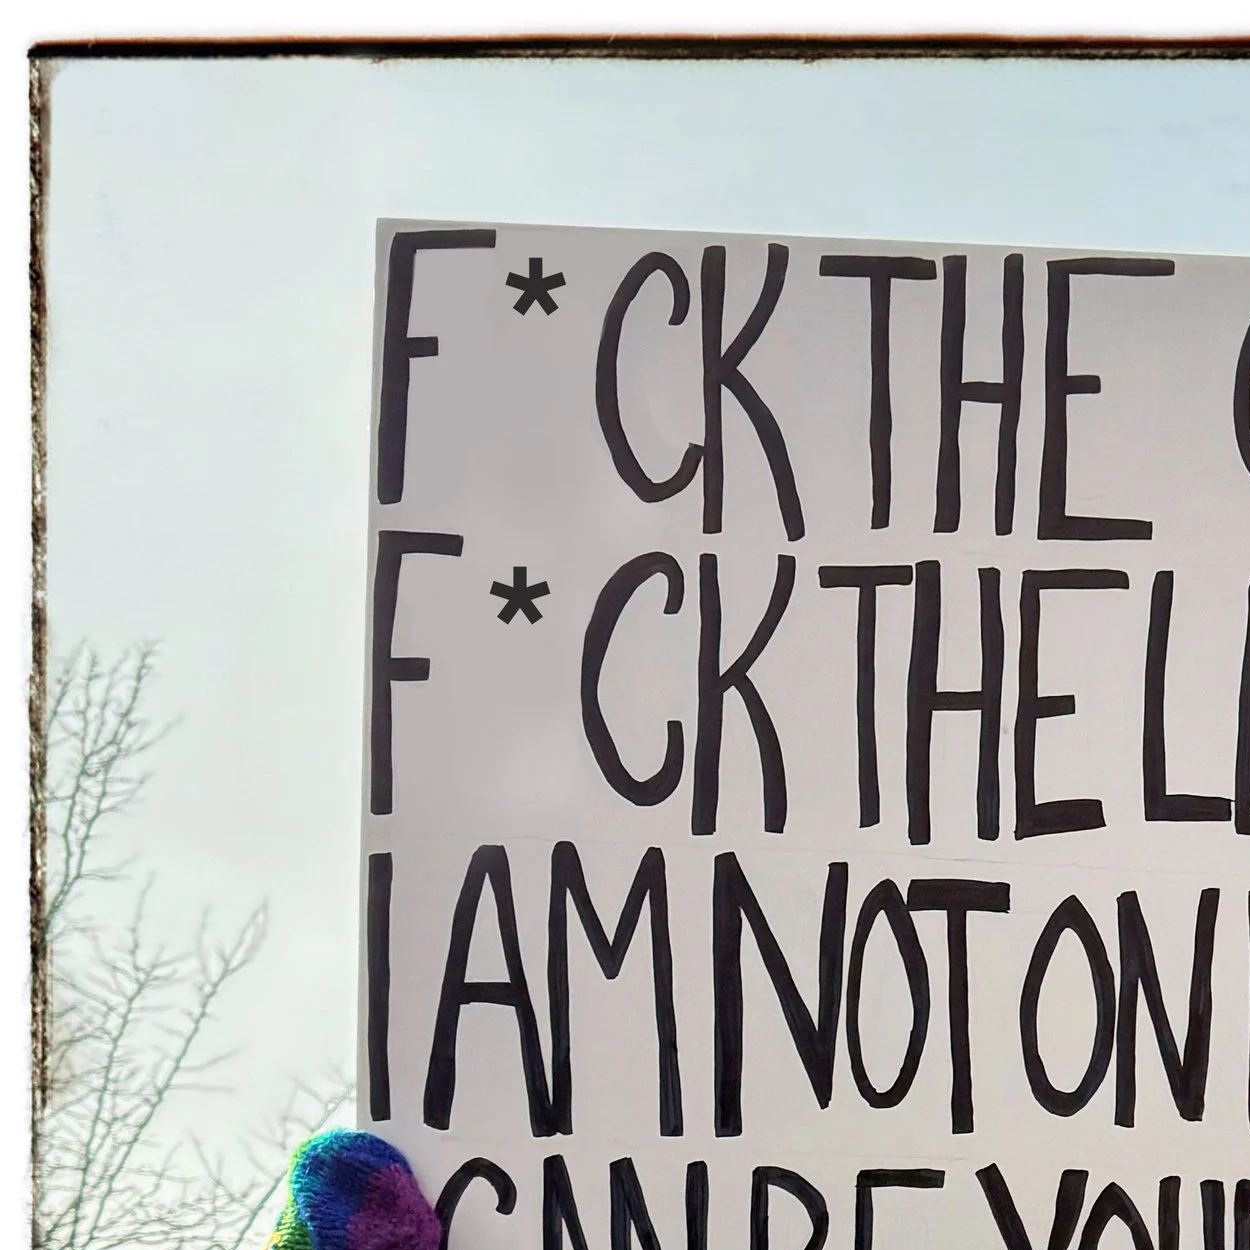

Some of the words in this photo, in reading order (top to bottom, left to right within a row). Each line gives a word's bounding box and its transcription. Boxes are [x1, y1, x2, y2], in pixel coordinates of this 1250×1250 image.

[819, 254, 1176, 540] THE
[818, 560, 1130, 845] THE
[368, 851, 393, 1122] I
[423, 840, 683, 1138] AM
[713, 848, 1011, 1137] NOT
[1019, 887, 1221, 1129] ON
